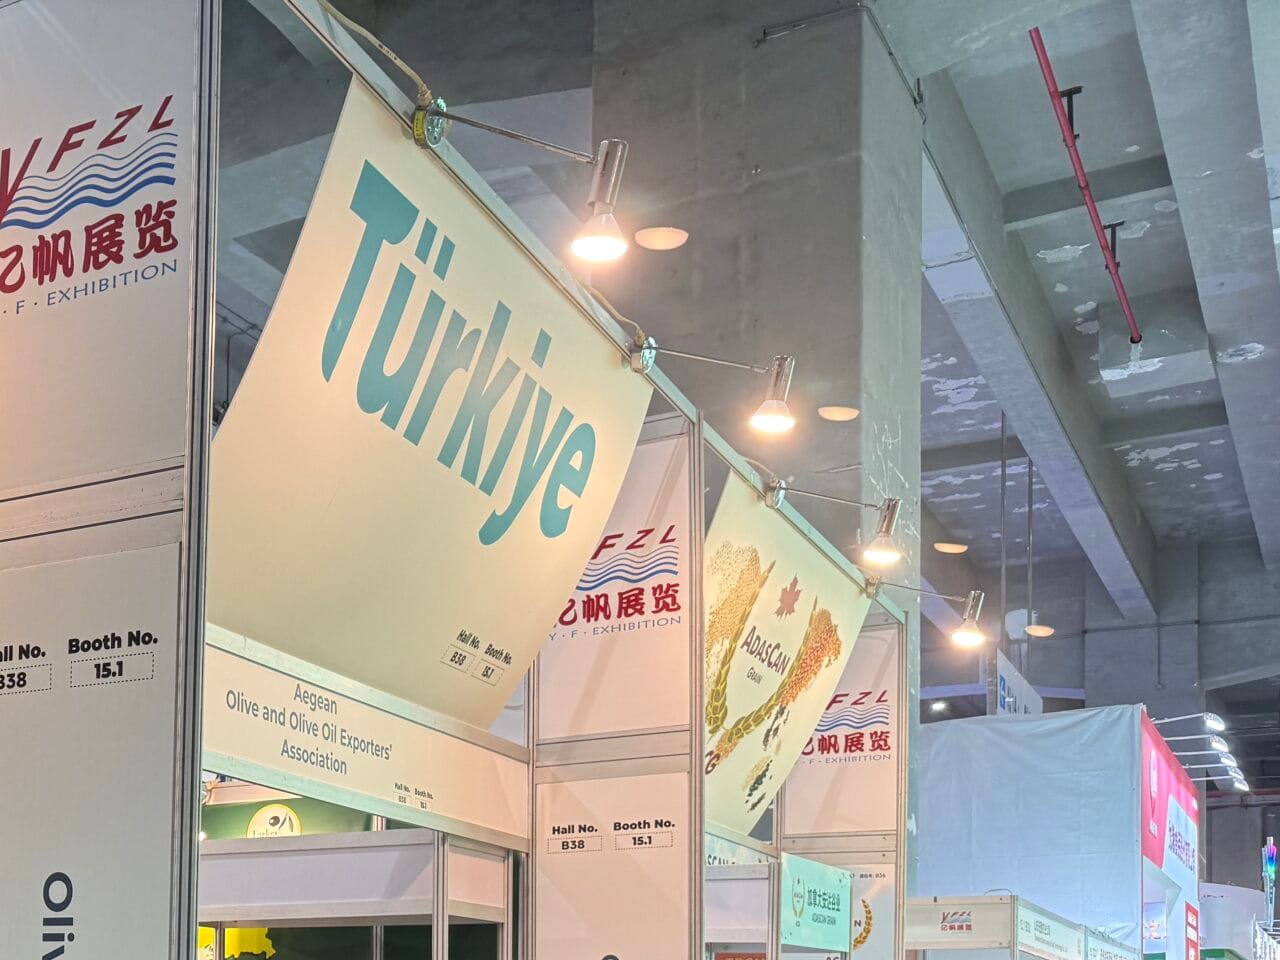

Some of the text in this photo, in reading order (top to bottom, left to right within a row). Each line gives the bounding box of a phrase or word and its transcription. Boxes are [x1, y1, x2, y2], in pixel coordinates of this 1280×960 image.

[321, 158, 597, 546] Türkiye
[590, 524, 676, 560] FZL
[68, 630, 158, 654] Booth No.
[18, 644, 46, 660] No.
[450, 651, 466, 666] B38
[94, 661, 123, 679] 15.1
[294, 683, 338, 715] Aegean
[826, 690, 888, 711] FZL
[226, 689, 392, 761] Olive and Olive Oil Exporters'
[281, 739, 347, 775] Association
[552, 824, 598, 835] Hall No.
[613, 819, 675, 831] Booth No.
[561, 840, 585, 850] B38
[632, 836, 652, 846] 15.1
